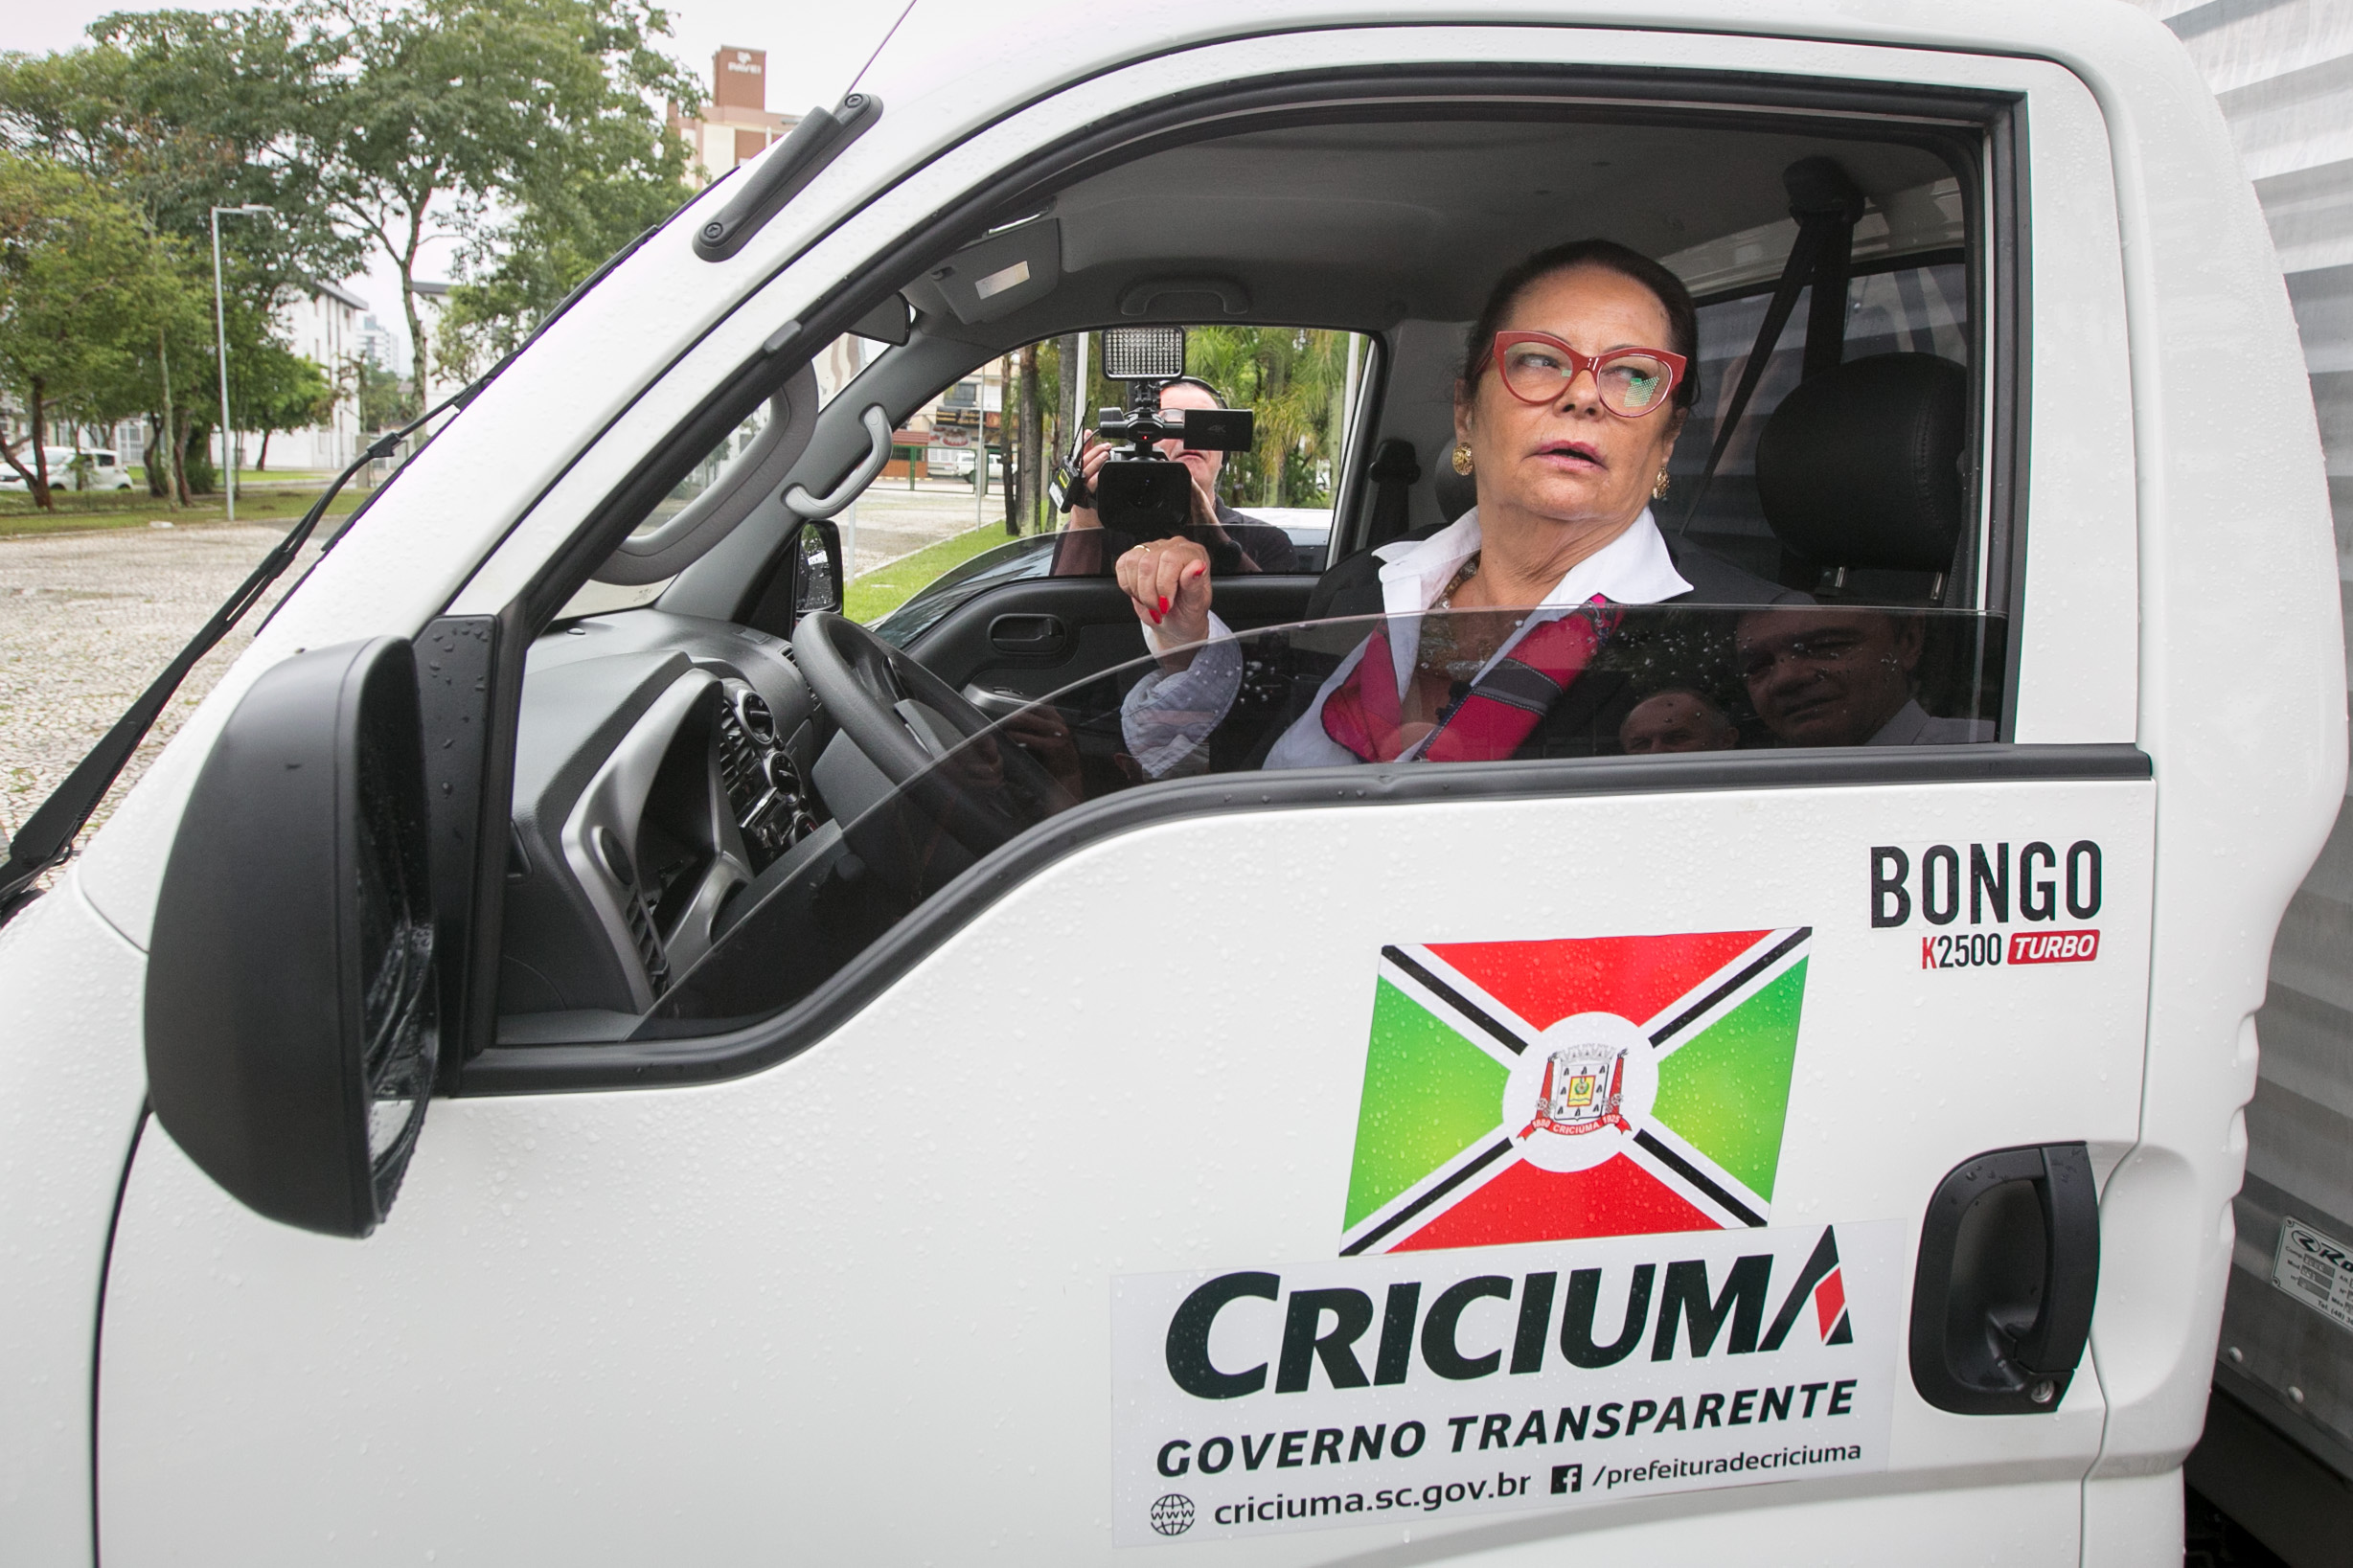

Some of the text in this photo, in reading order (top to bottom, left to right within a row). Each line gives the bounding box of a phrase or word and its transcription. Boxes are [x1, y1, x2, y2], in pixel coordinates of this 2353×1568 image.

[1870, 839, 2102, 928] BONGO
[1922, 933, 2095, 969] K2500 TURBO
[1165, 1224, 1854, 1400] CRICIUMA
[1156, 1379, 1858, 1478] GOVERNO TRANSPARENTE
[1214, 1472, 1531, 1525] criciuma.sc.gov.br
[1592, 1444, 1862, 1489] /prefeituradecriciuma
